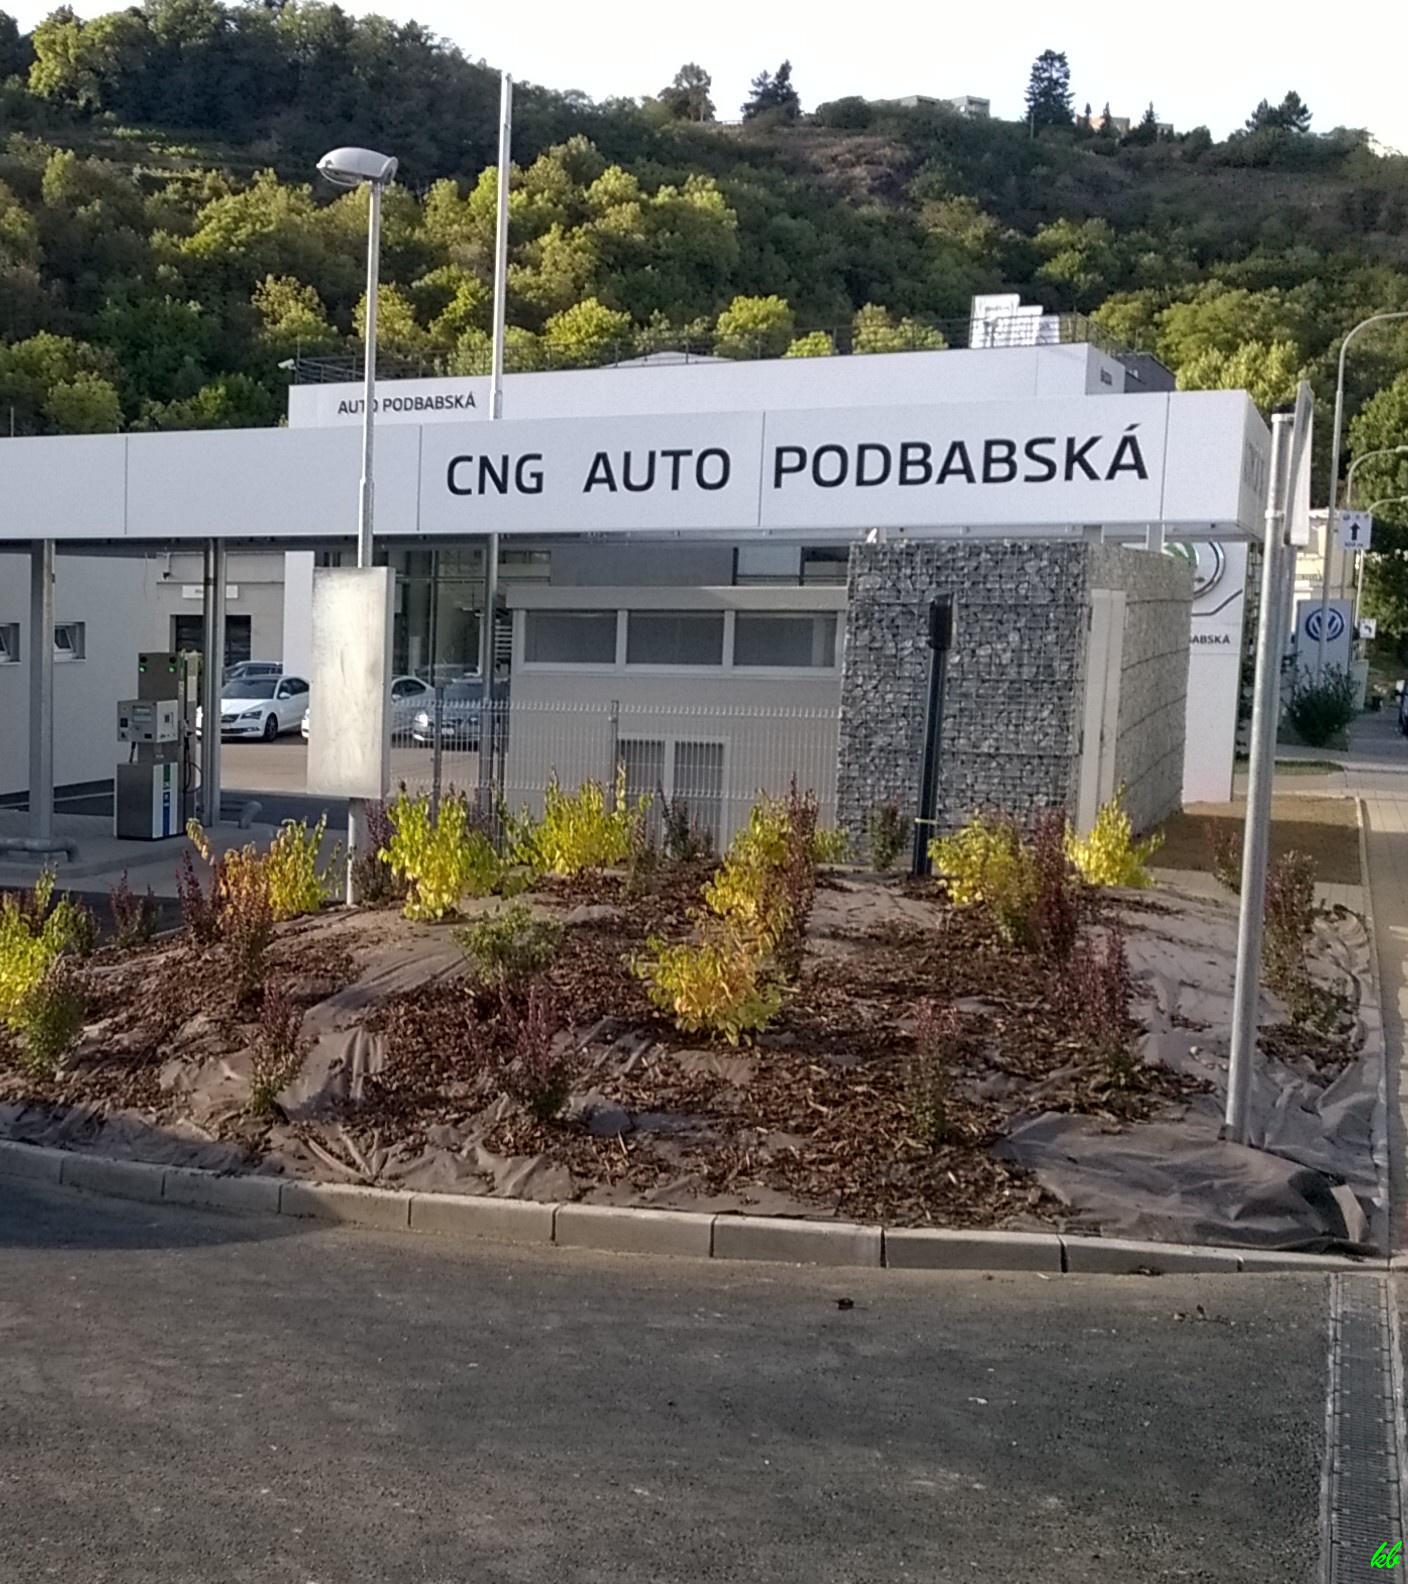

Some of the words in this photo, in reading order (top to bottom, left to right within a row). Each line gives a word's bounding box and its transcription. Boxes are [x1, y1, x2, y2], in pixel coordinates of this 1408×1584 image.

[382, 391, 476, 412] PODBABSKÁ
[447, 453, 544, 495] CNG
[583, 448, 731, 492] AUTO
[773, 423, 1149, 489] PODBABSKÁ
